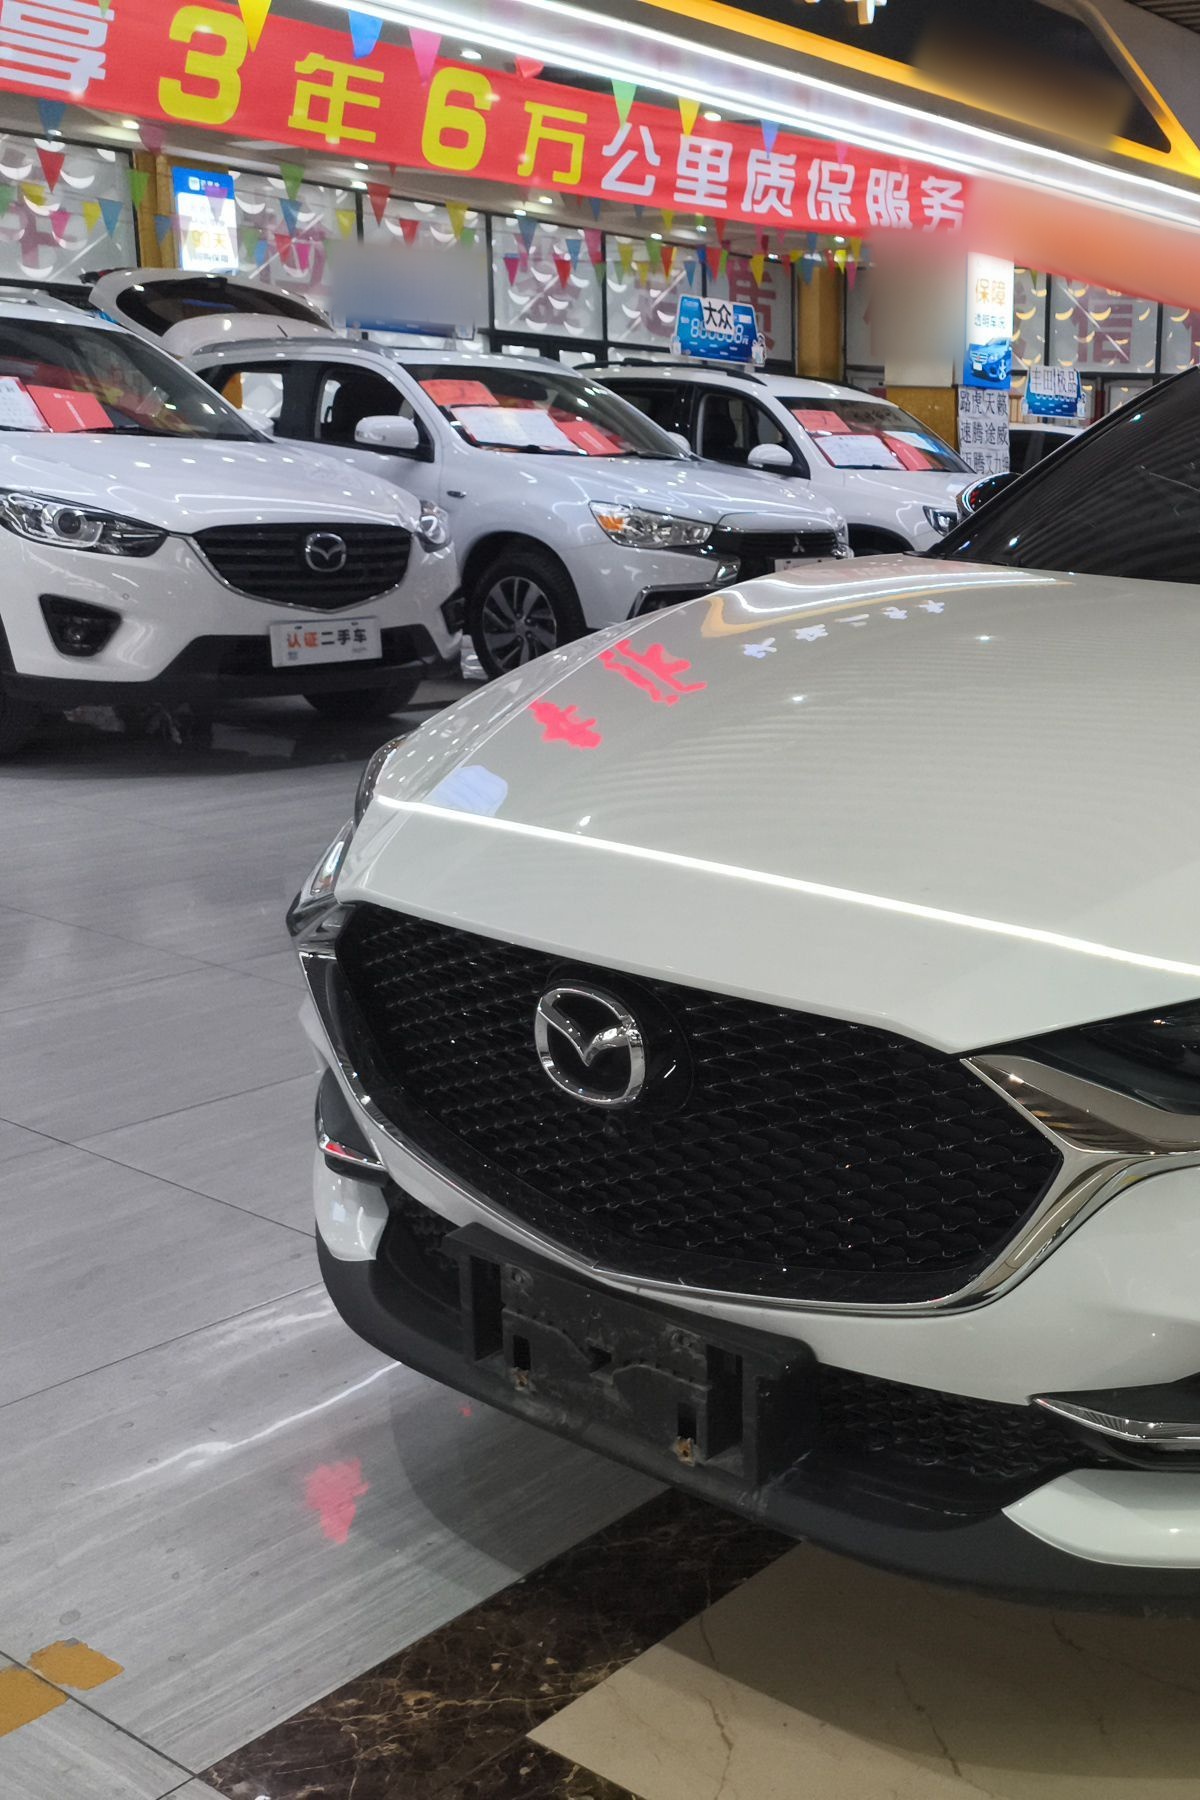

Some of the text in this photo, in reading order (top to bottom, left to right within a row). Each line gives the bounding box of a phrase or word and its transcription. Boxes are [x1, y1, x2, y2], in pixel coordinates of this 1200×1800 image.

[703, 301, 732, 330] 大众
[287, 628, 367, 648] 认证二手车
